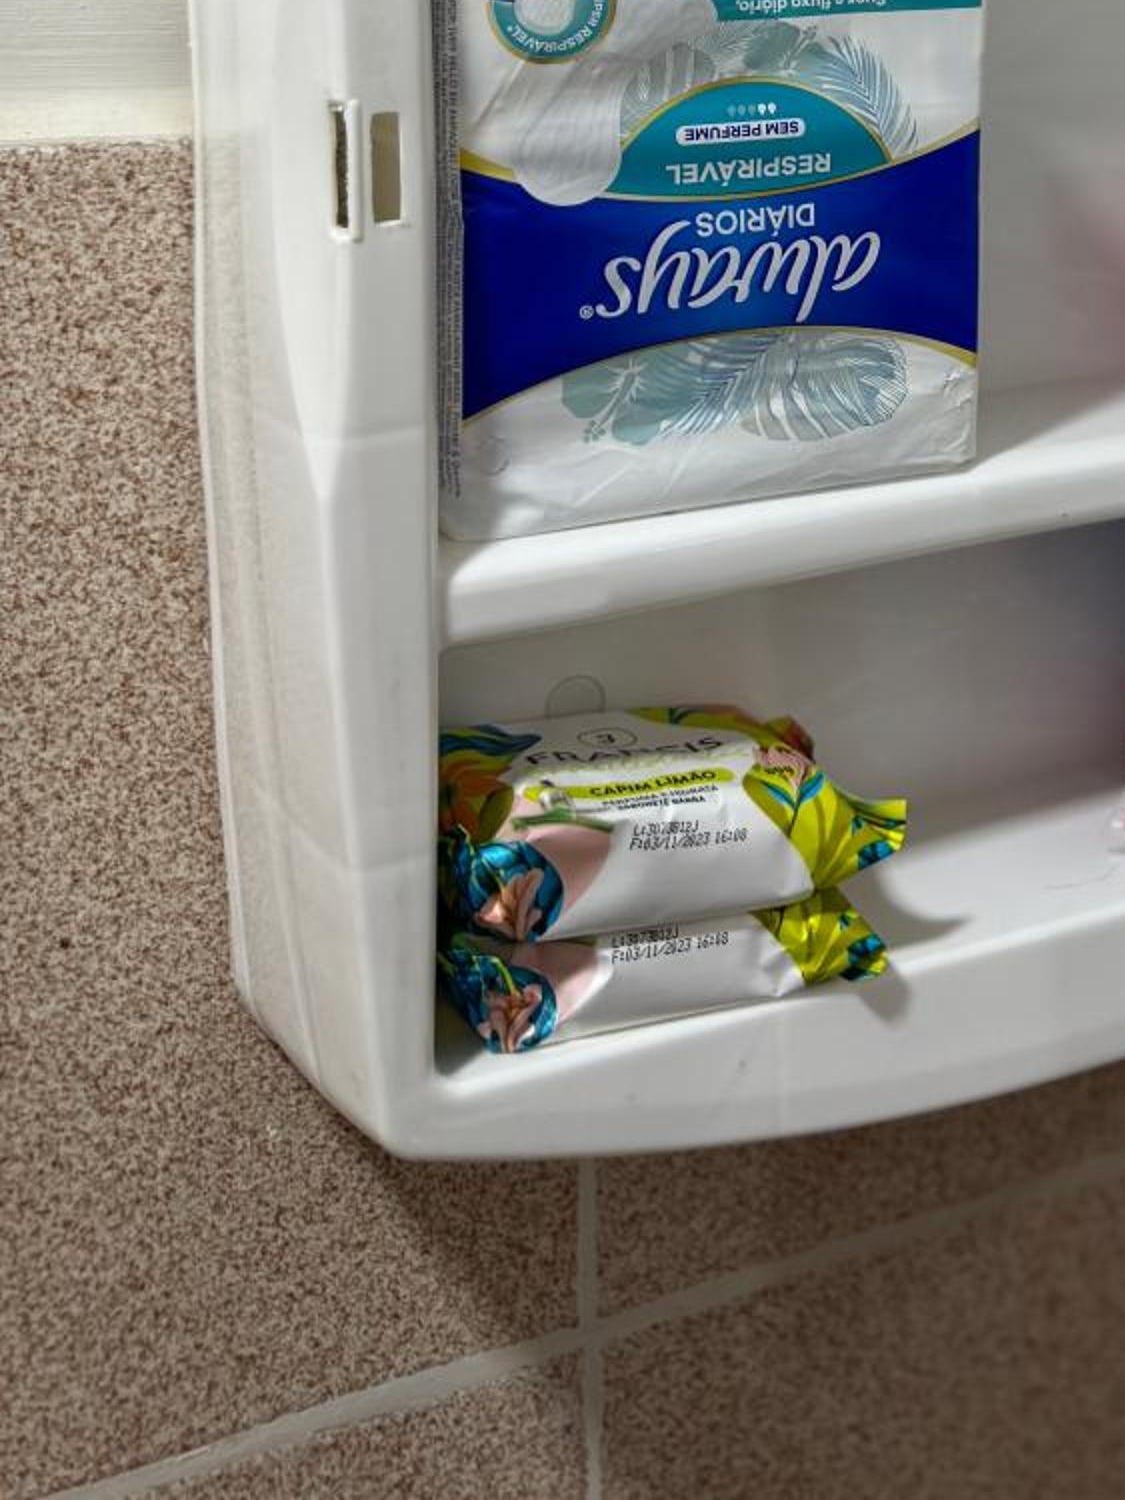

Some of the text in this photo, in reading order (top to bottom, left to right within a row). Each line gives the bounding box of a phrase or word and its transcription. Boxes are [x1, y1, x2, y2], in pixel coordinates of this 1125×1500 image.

[684, 120, 800, 142] SEM PERFUME
[666, 151, 832, 185] RESPIRÁVEL
[694, 203, 816, 237] DIÁRIOS
[588, 770, 717, 798] CAPIM LIMÃO
